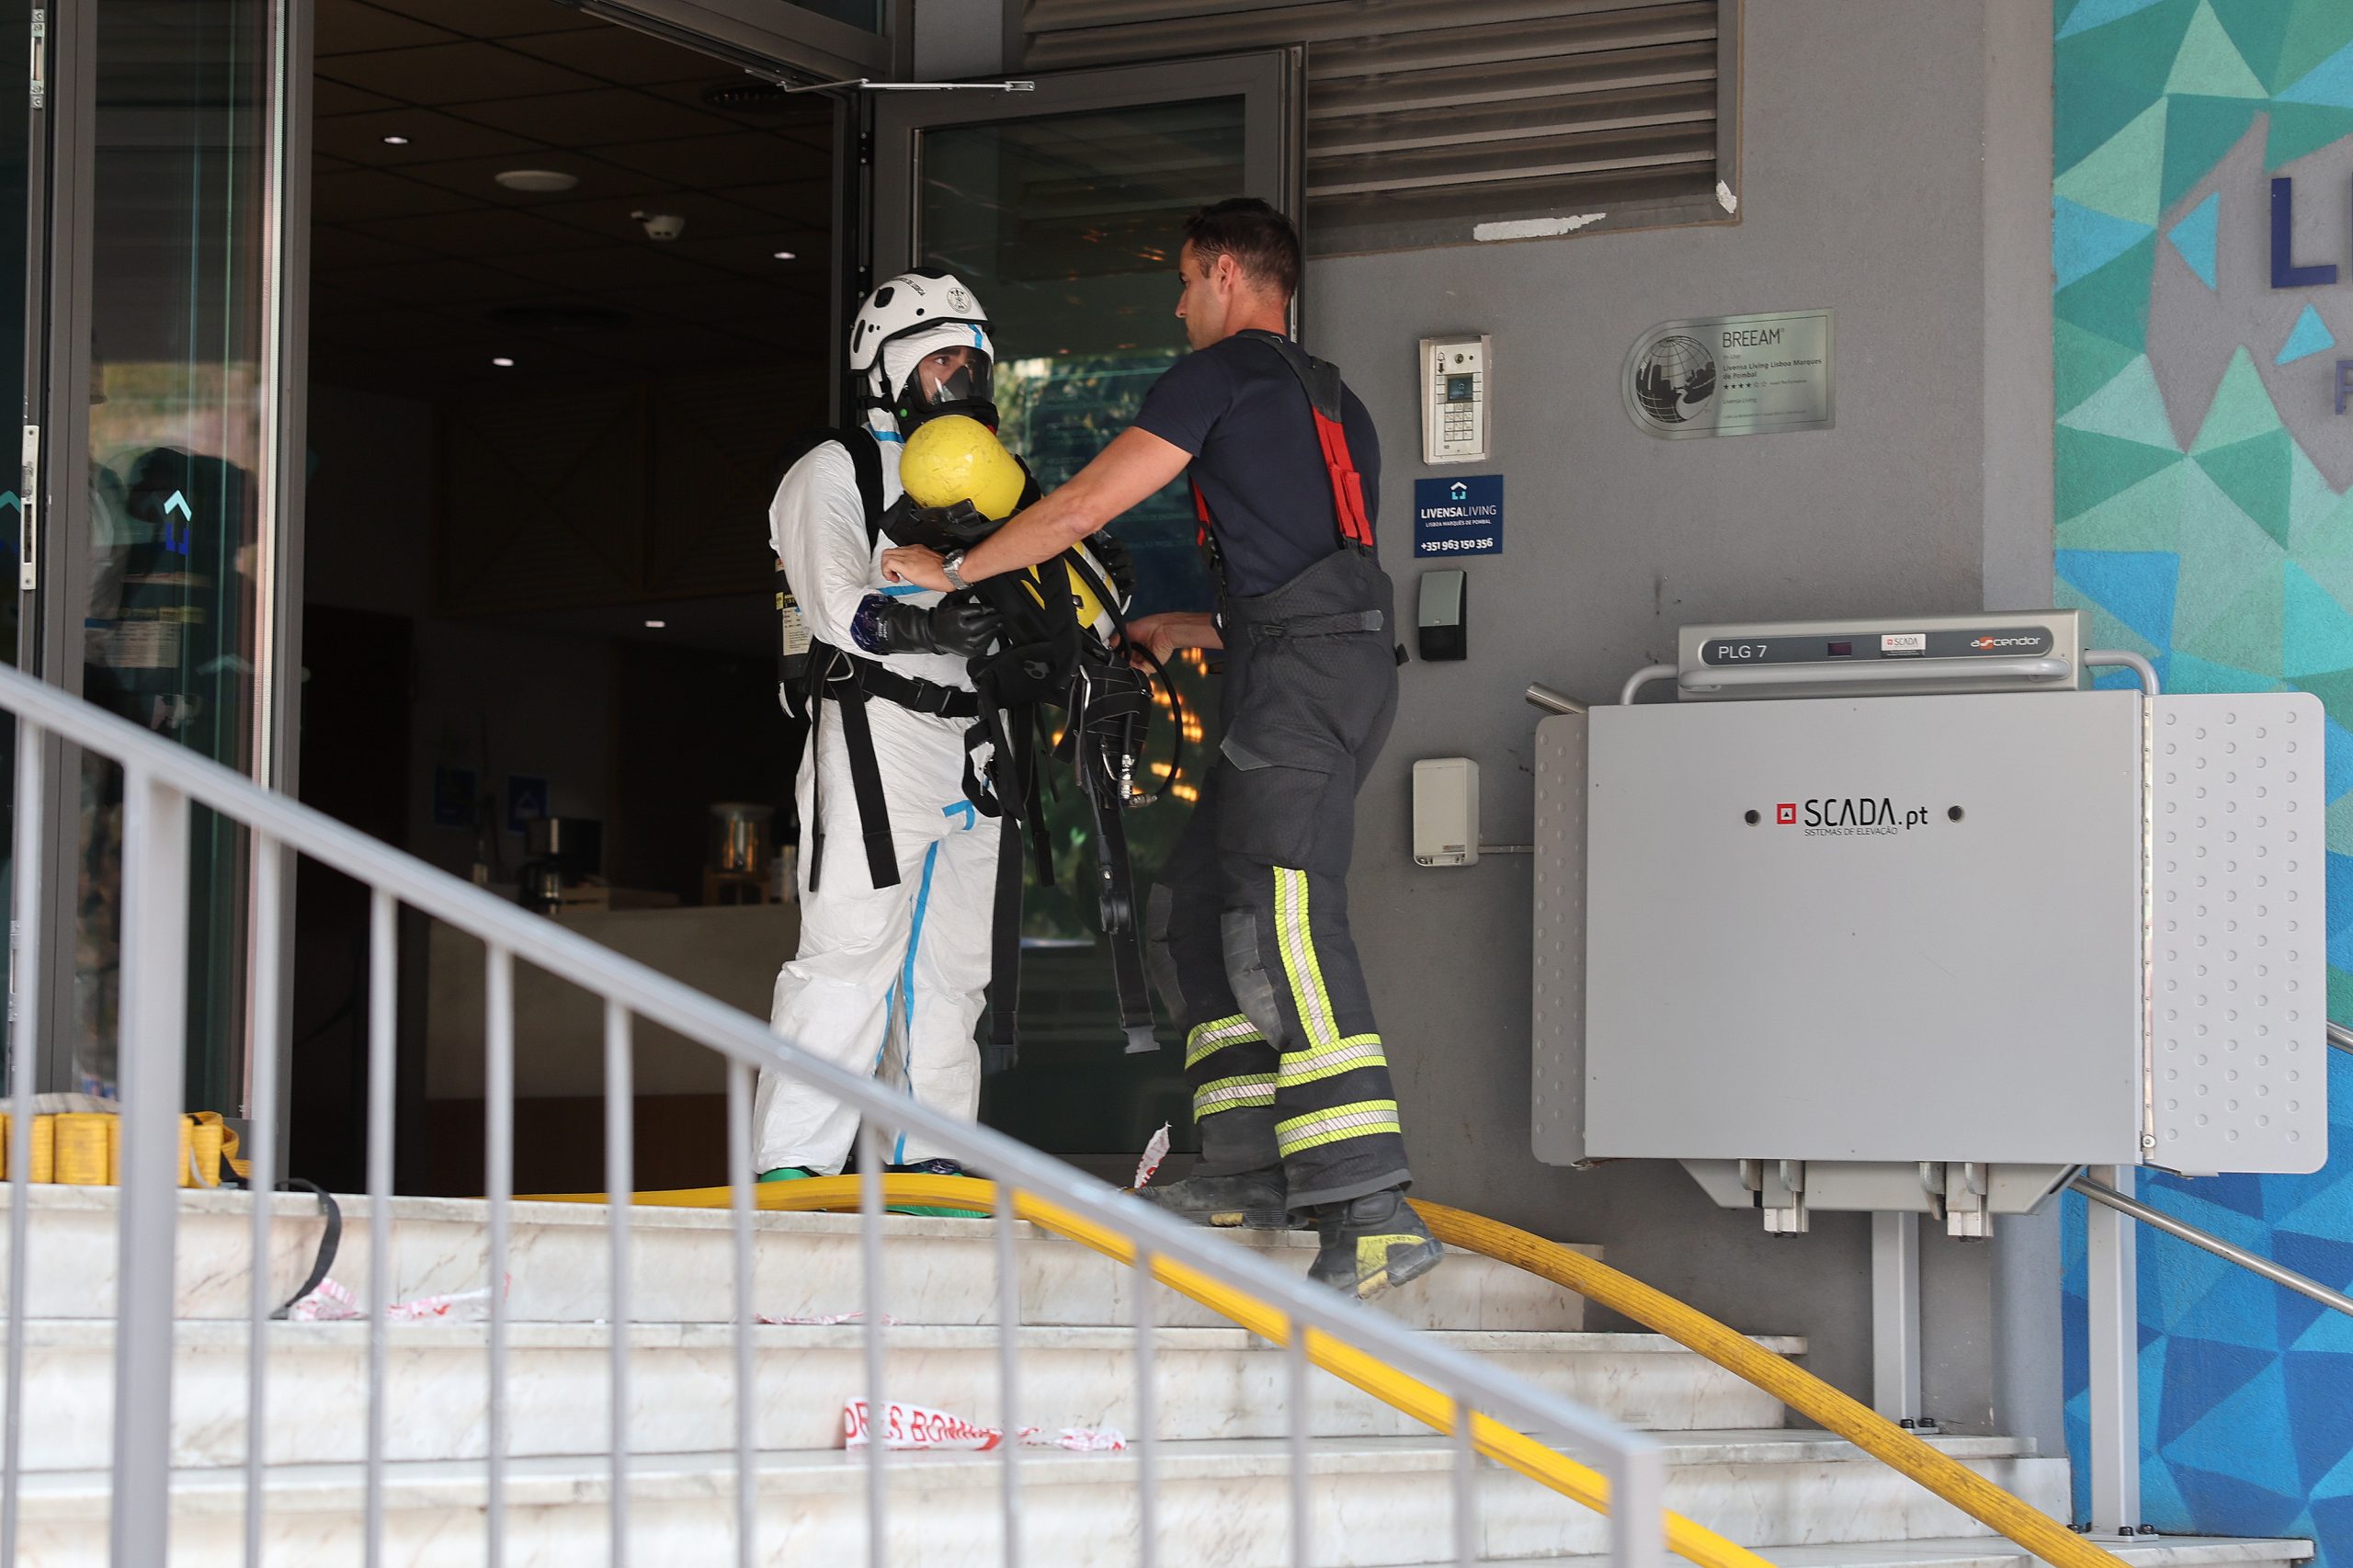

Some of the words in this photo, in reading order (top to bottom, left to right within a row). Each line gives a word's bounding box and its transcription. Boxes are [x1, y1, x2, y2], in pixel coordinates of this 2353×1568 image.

[2271, 175, 2353, 289] L
[1722, 327, 1781, 348] BREEAM
[1421, 541, 1441, 551] +351
[1441, 540, 1460, 551] 963
[1461, 539, 1475, 550] 150
[1476, 538, 1493, 549] 356
[1718, 645, 1752, 659] PLG
[1756, 645, 1768, 658] 7
[1804, 828, 1842, 836] SISTEMAS
[1844, 827, 1855, 835] DE
[1857, 825, 1898, 836] ELEVAÇÃO
